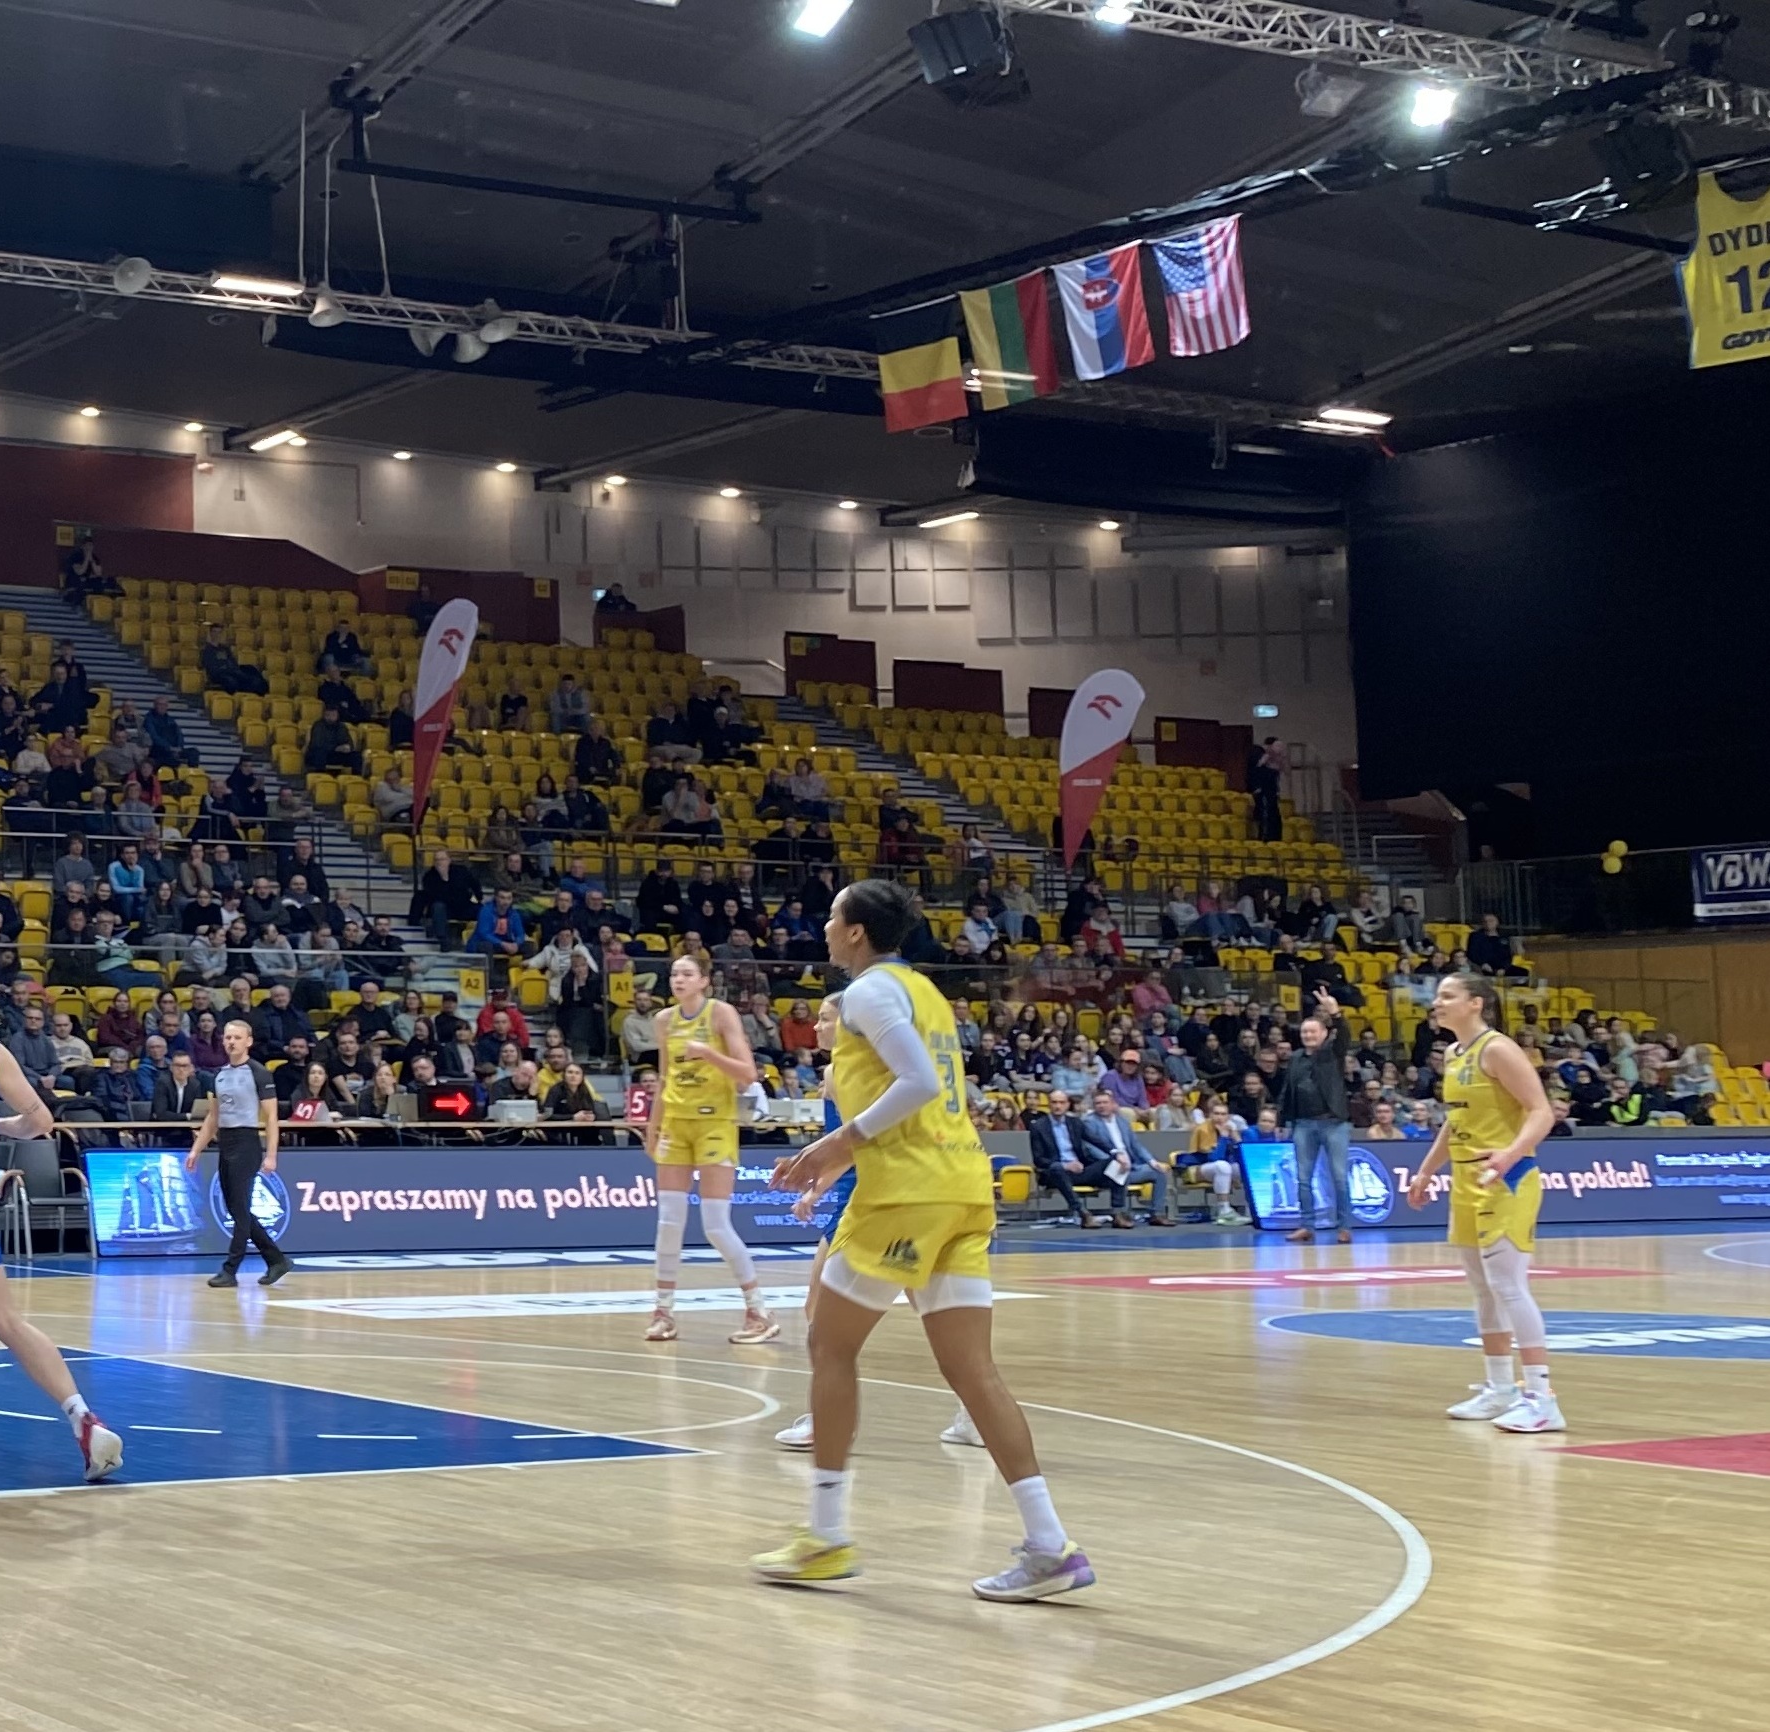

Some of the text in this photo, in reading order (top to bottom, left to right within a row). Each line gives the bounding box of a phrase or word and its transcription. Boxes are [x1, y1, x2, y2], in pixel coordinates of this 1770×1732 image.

[465, 978, 480, 989] A2
[615, 982, 629, 992] A1
[632, 1091, 646, 1114] 5
[1540, 1172, 1569, 1190] na
[1573, 1161, 1653, 1201] pokład!
[296, 1174, 657, 1221] Zapraszamy na pokład!
